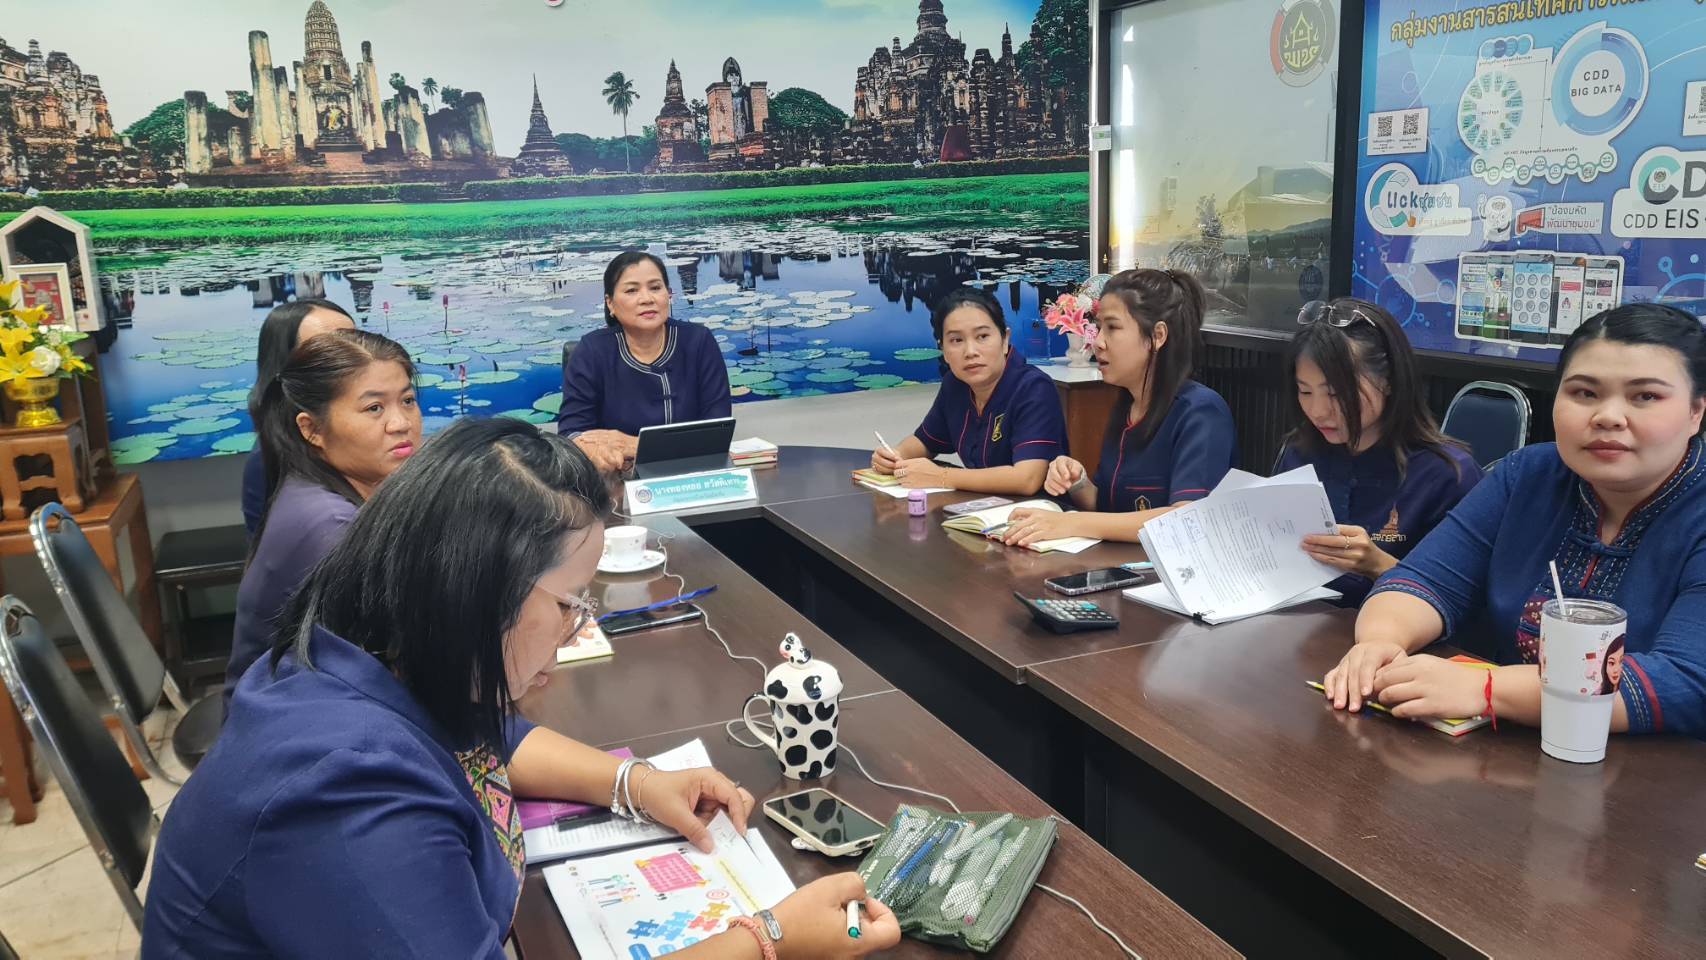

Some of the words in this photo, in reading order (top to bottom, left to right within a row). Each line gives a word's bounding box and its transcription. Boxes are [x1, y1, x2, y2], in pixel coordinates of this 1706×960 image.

[1583, 69, 1609, 81] CDD
[1571, 87, 1589, 97] BIG
[1593, 84, 1621, 95] DATA
[1623, 214, 1658, 229] CDD
[1665, 208, 1699, 229] EIS
